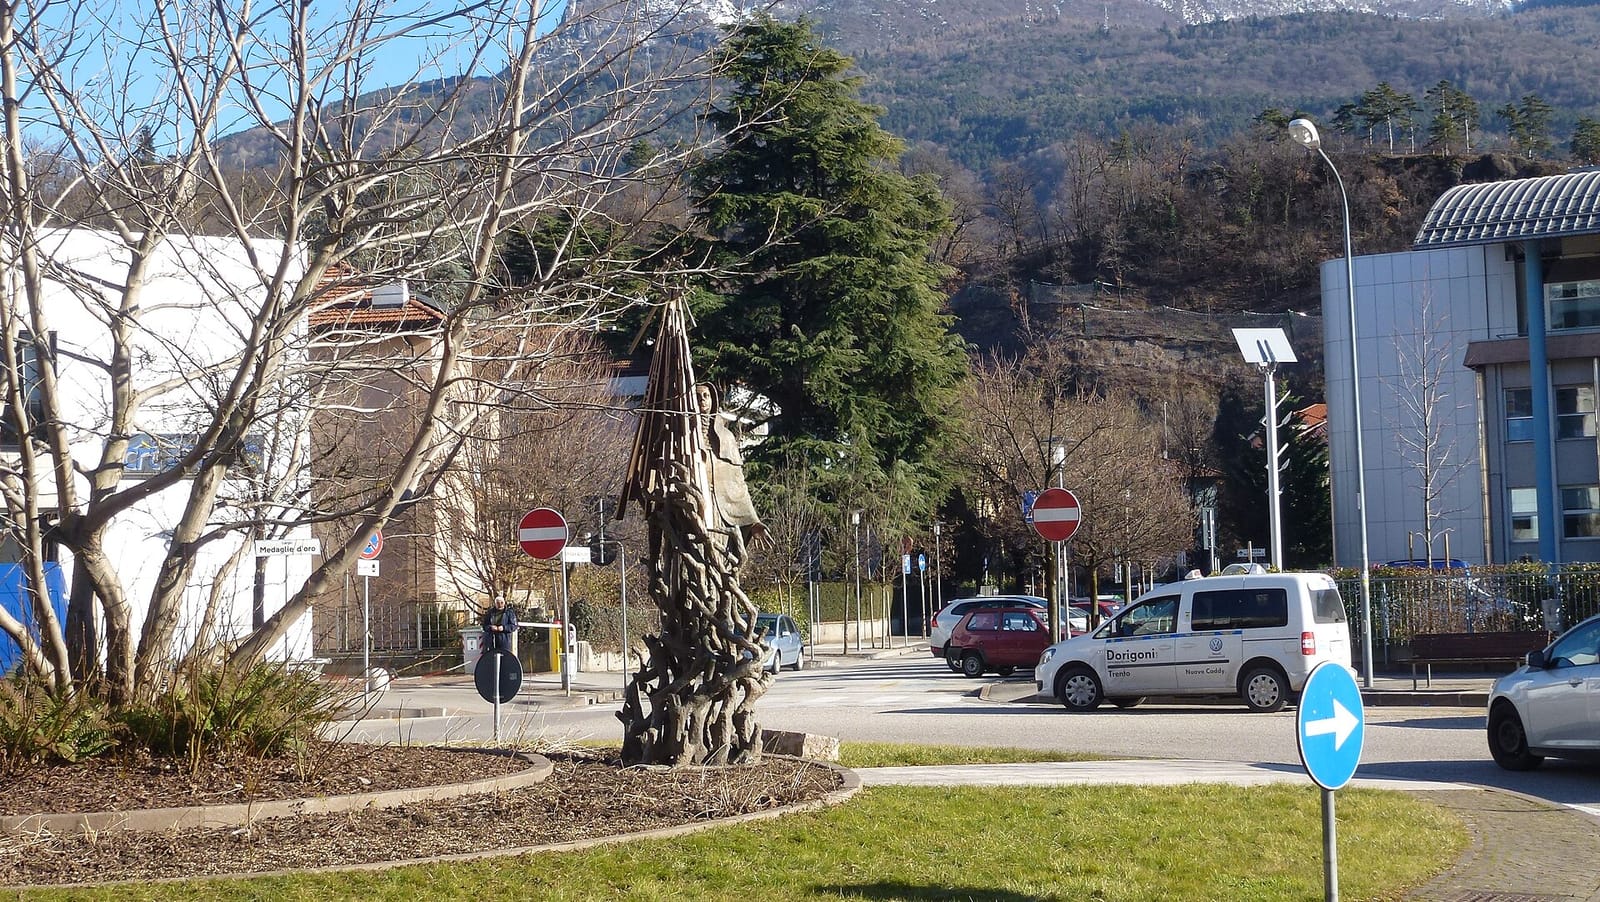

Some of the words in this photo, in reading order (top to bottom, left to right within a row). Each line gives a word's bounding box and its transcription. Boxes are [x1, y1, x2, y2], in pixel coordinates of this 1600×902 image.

[259, 545, 294, 554] Medaglie
[1107, 648, 1155, 662] Dorigoni
[1108, 670, 1131, 678] Trento
